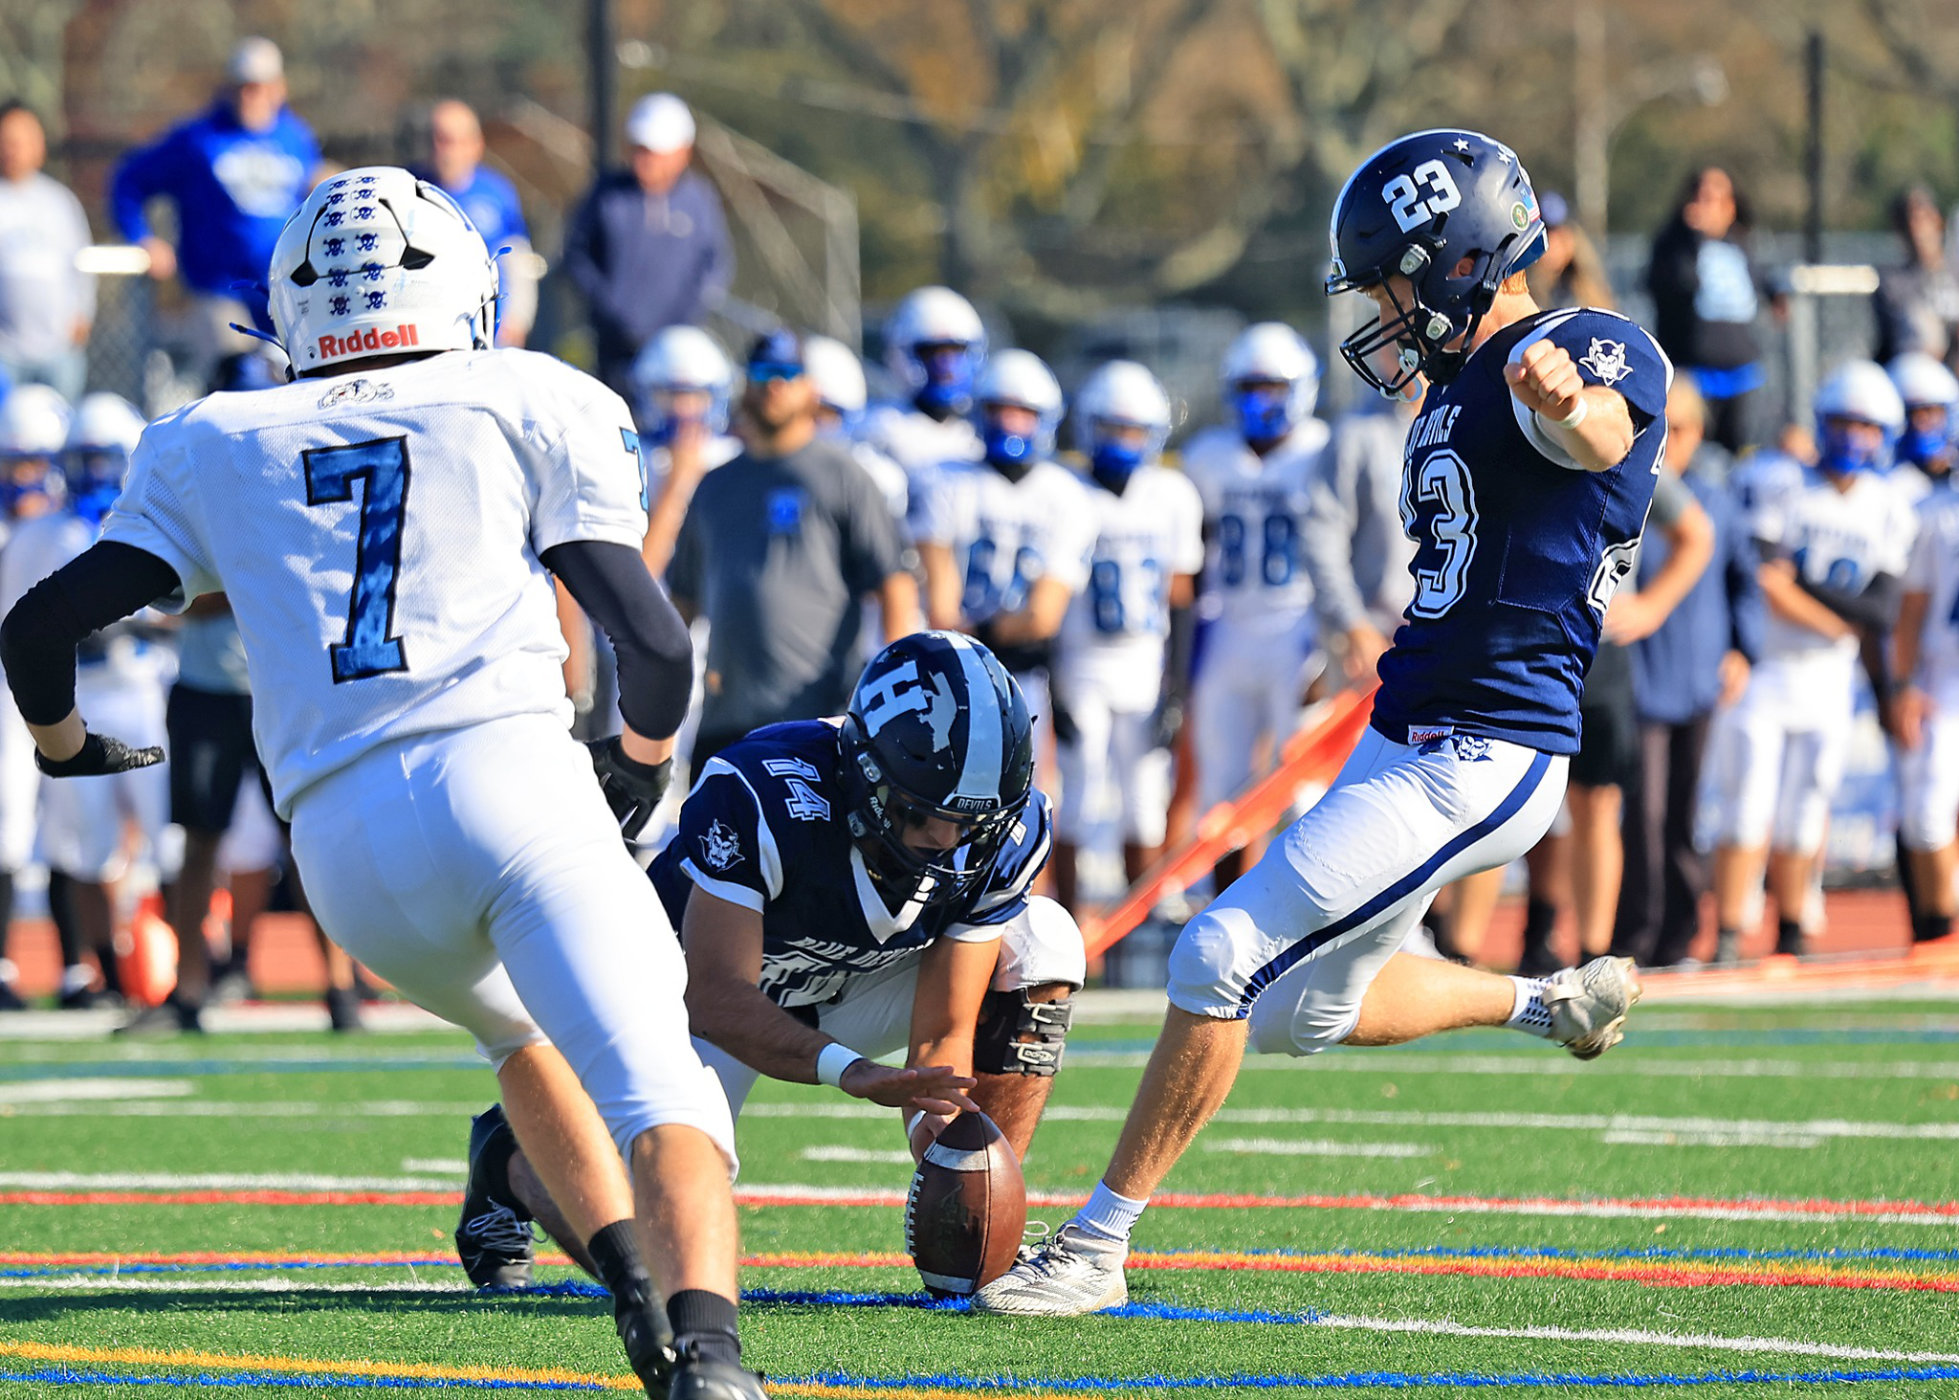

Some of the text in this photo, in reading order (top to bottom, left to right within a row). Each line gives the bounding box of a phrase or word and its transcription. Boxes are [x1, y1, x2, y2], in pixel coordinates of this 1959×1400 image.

[1381, 158, 1462, 235] 23
[317, 322, 420, 360] Riddell
[300, 434, 412, 685] 7
[1399, 447, 1480, 620] 3
[761, 756, 832, 822] 14
[956, 797, 993, 810] DEVILS
